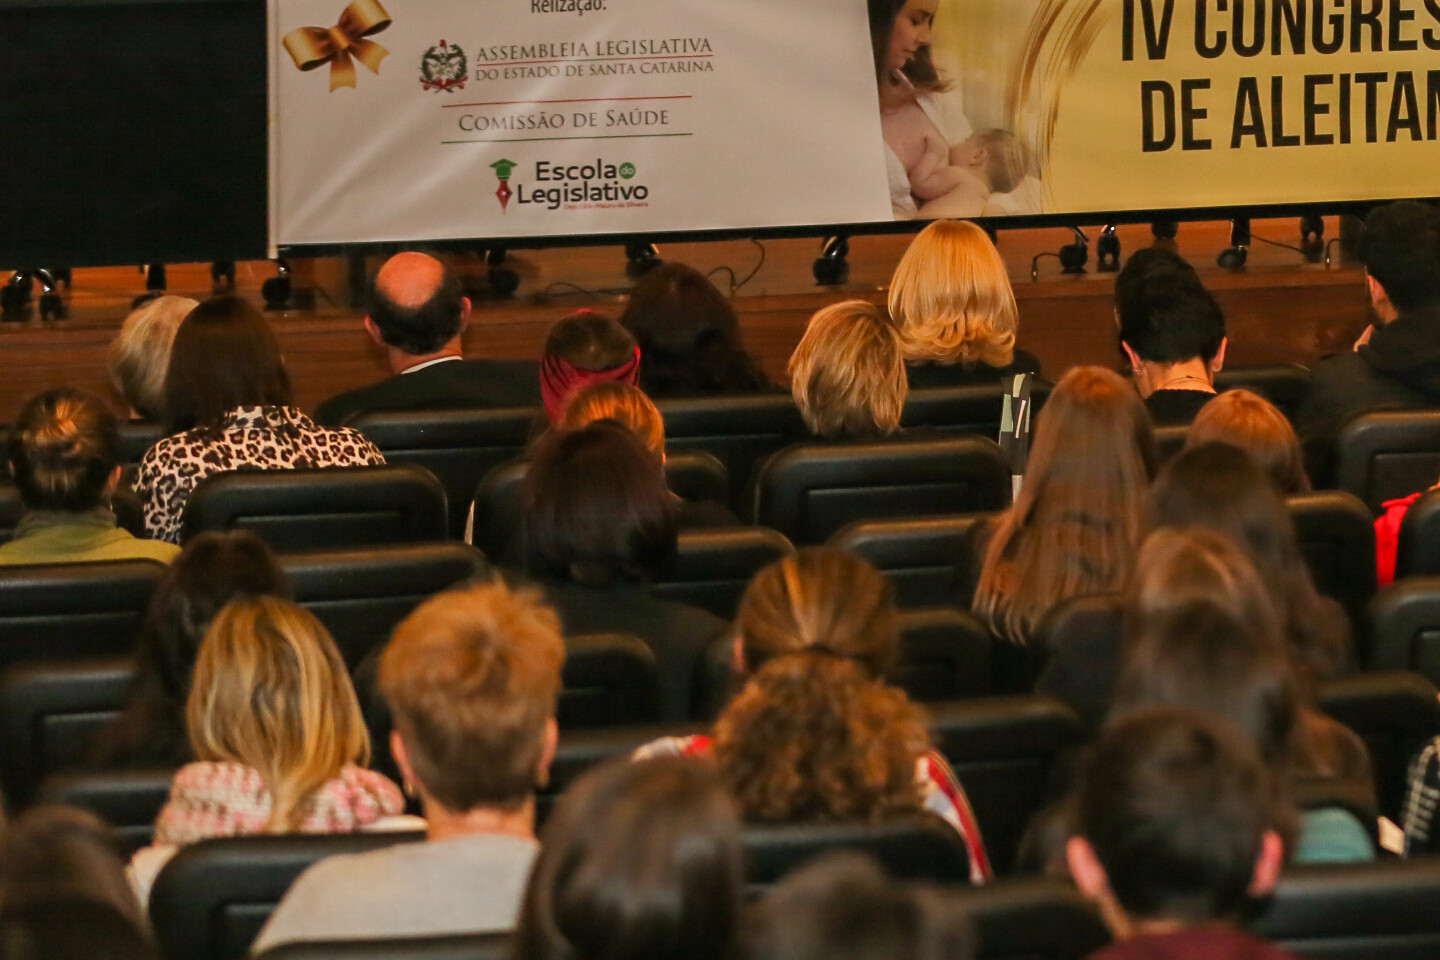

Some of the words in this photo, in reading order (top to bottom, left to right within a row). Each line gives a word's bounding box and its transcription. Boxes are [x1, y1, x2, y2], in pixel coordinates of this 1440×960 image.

[476, 41, 589, 62] ASSEMBLEIA
[596, 37, 713, 56] LEGISLATIVA
[476, 68, 499, 81] DO
[503, 65, 560, 80] ESTADO
[565, 63, 584, 77] DE
[589, 62, 636, 76] SANTA
[640, 59, 714, 74] CATARINA
[573, 112, 598, 128] DE
[1140, 79, 1212, 153] DE
[536, 158, 617, 181] Escola
[620, 165, 634, 175] do
[517, 181, 649, 210] Legislativo
